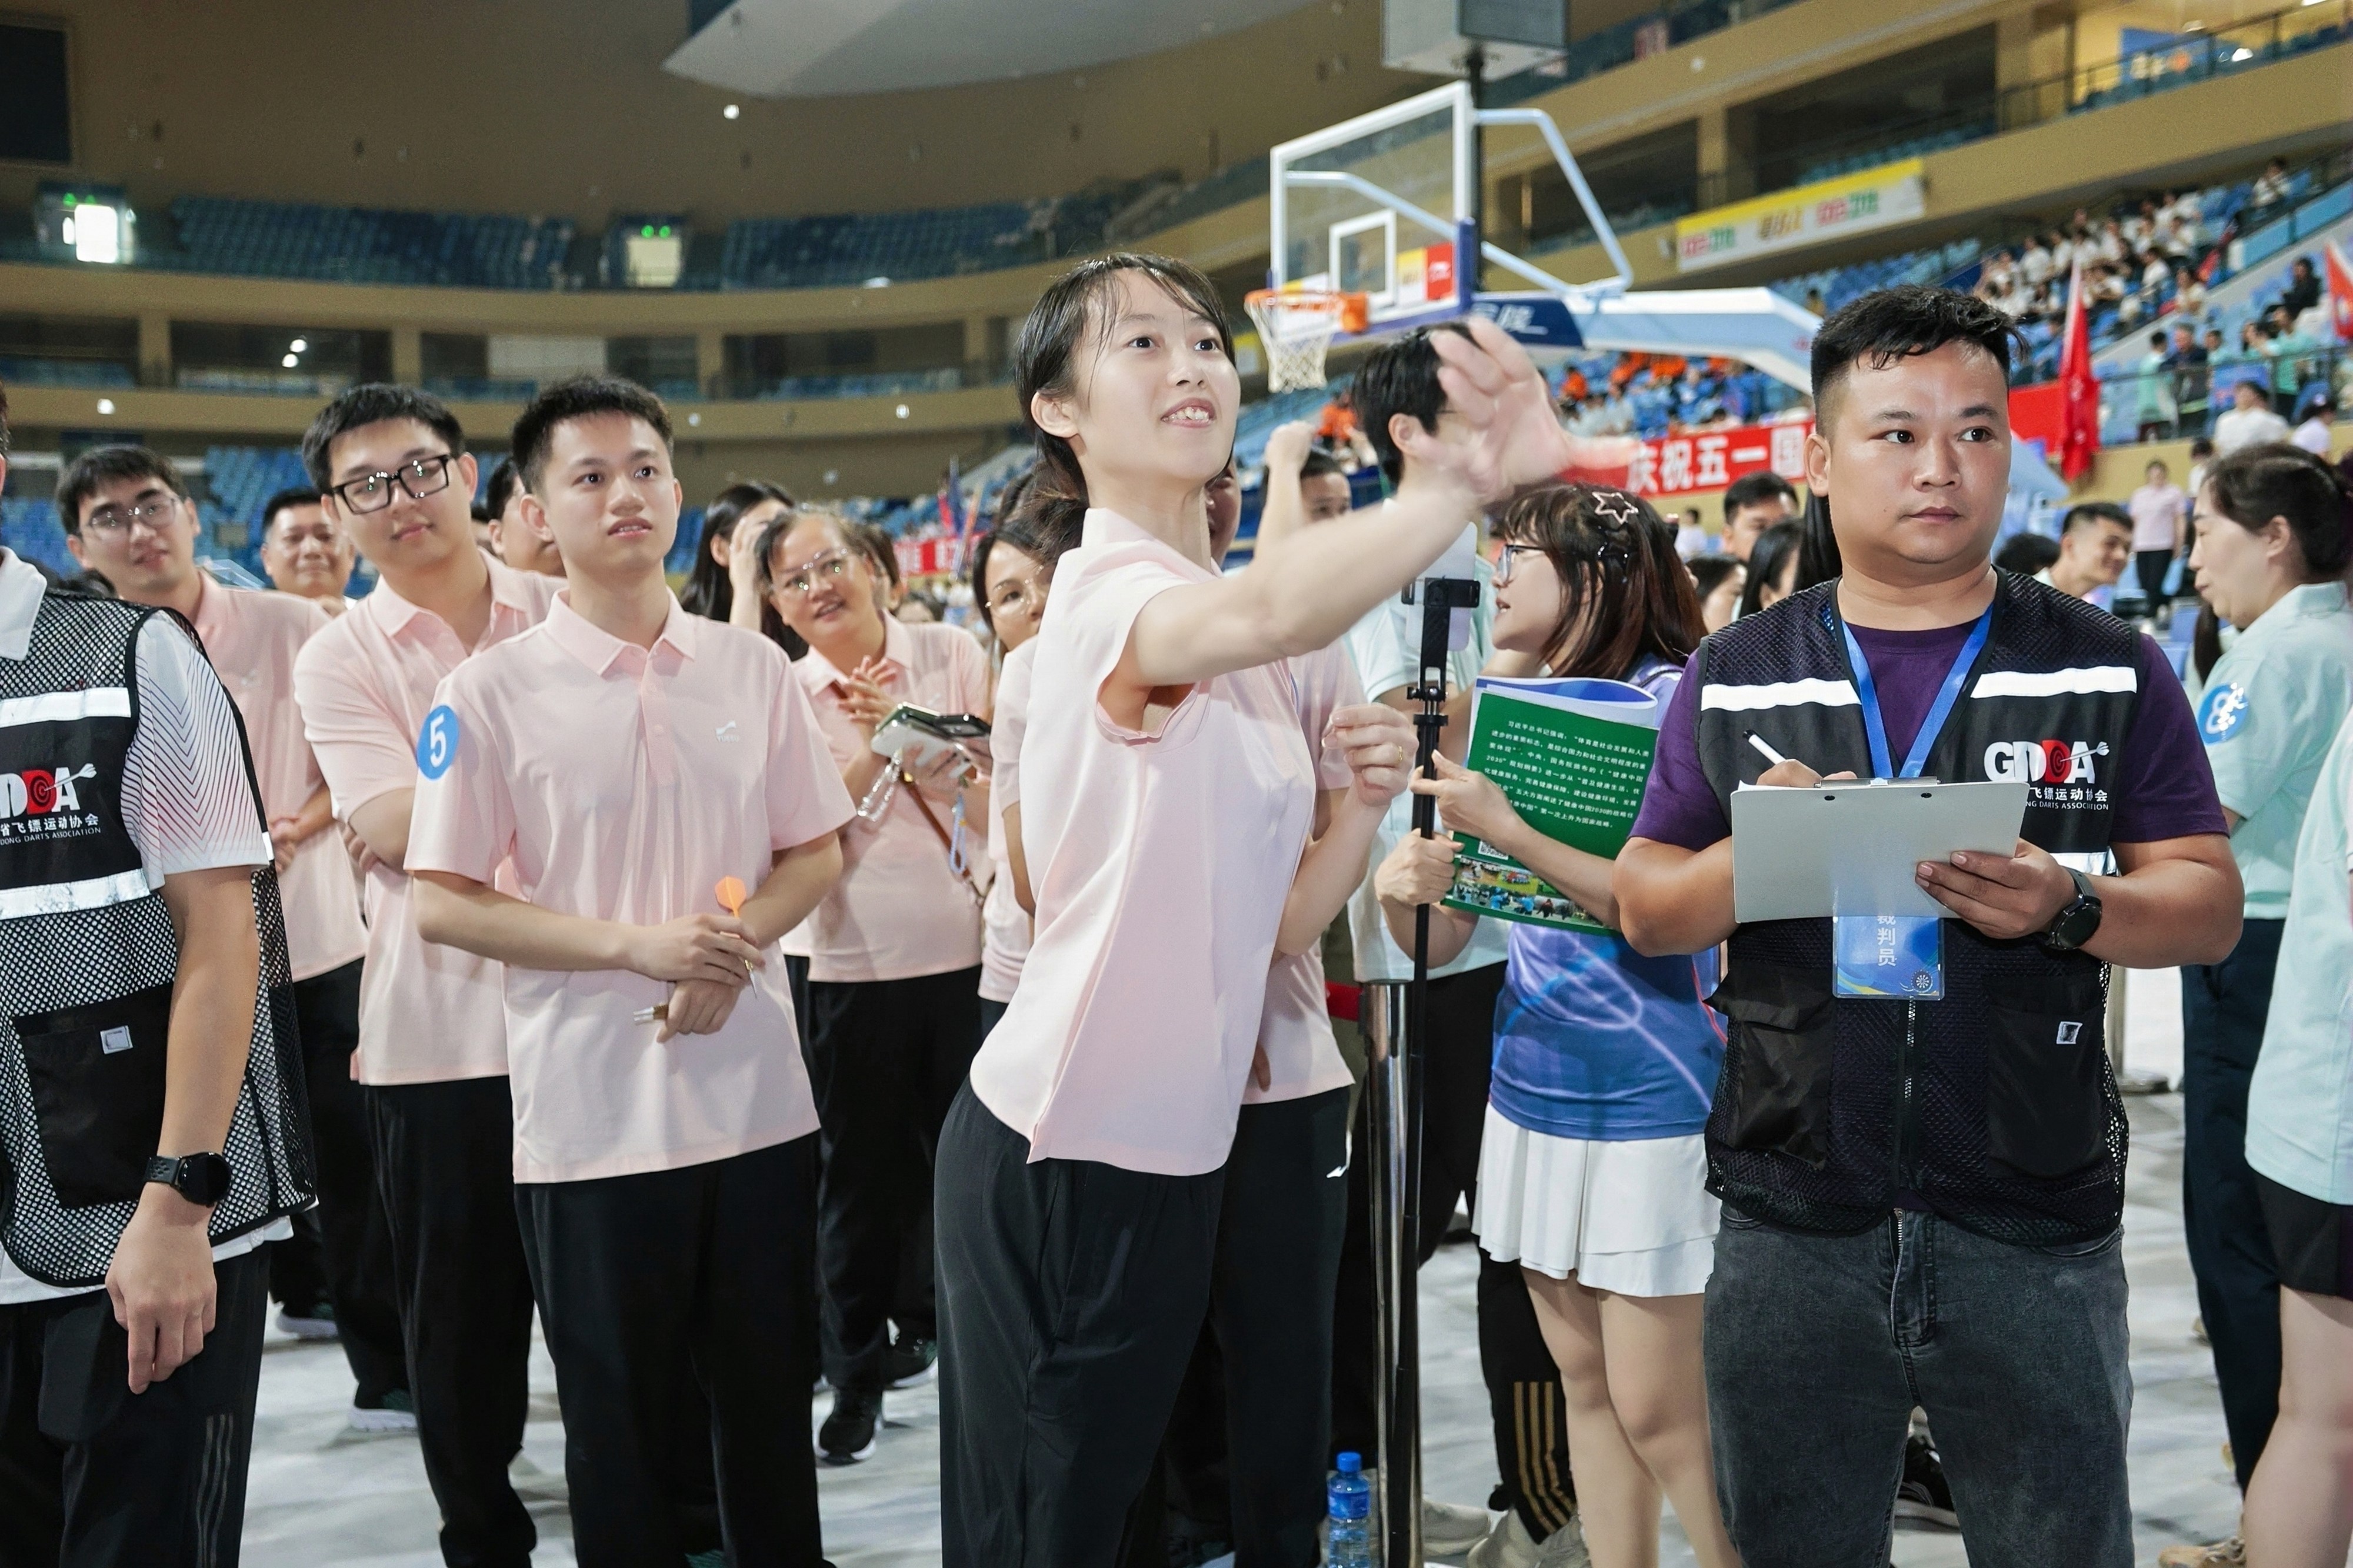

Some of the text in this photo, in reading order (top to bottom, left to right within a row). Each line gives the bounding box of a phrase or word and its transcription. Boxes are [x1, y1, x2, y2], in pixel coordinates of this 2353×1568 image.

[1625, 423, 1816, 493] 庆祝五一国
[430, 713, 446, 768] 5
[1984, 740, 2095, 784] GDDA
[2029, 786, 2108, 802] 飞镖运动协会
[2039, 801, 2059, 809] DARTS
[0, 813, 99, 836] 省飞镖运动协会
[24, 832, 50, 843] DARTS
[52, 827, 101, 839] ASSOCIATION
